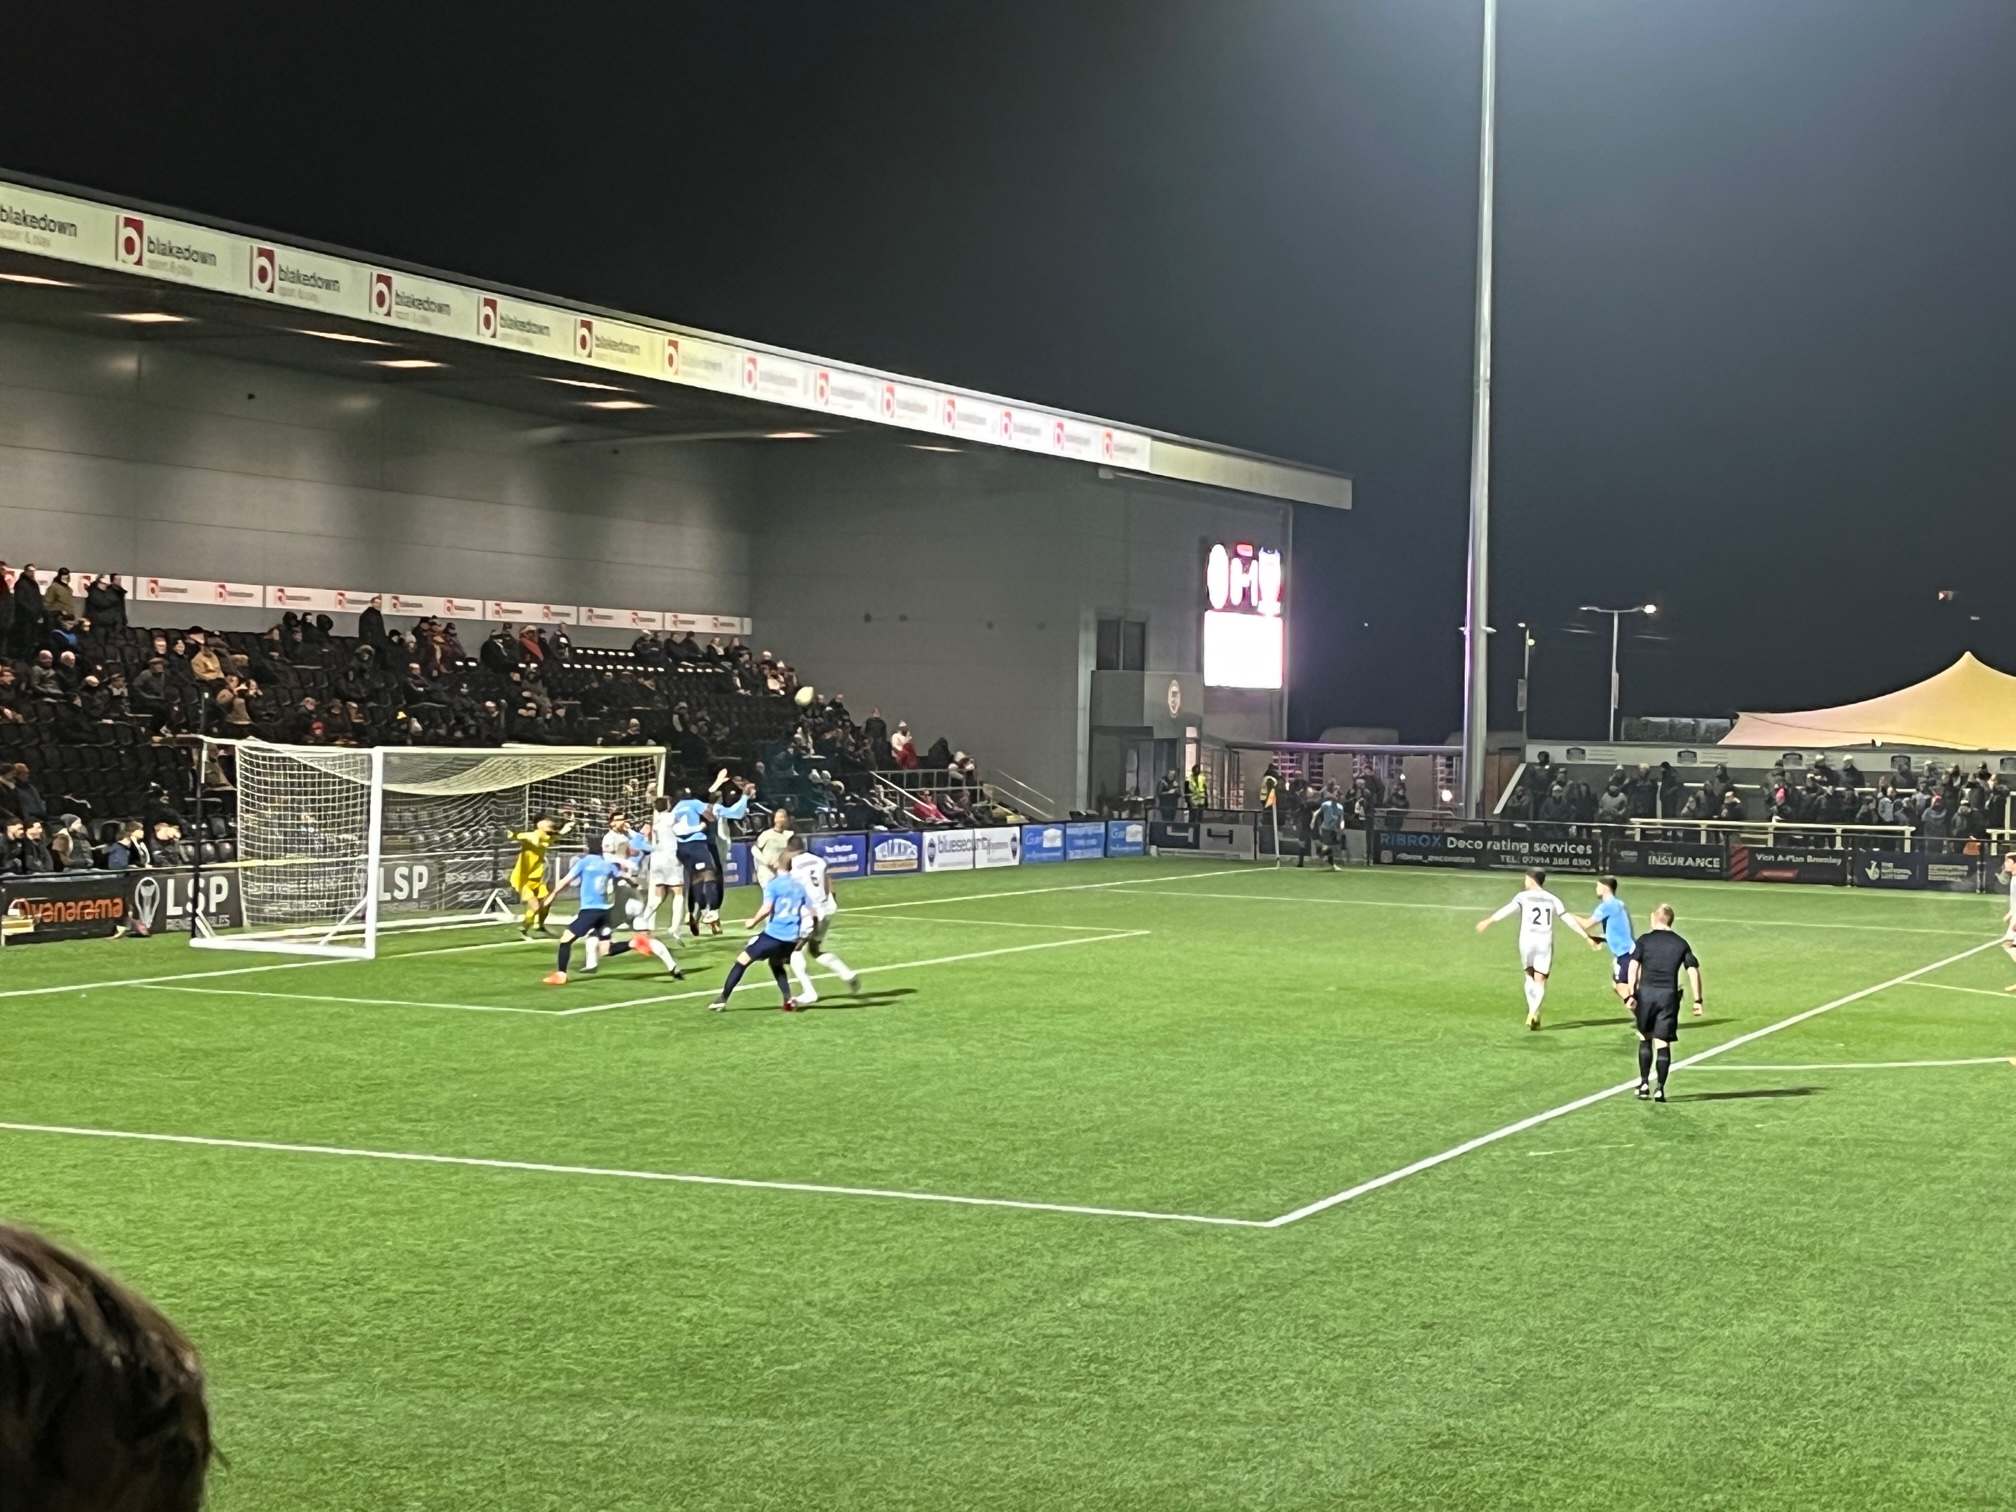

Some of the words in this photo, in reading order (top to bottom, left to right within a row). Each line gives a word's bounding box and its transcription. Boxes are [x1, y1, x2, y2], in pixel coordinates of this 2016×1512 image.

[147, 236, 217, 266] blakedown
[1533, 841, 1593, 855] services
[1647, 855, 1721, 868] INSURANCE
[378, 865, 429, 902] LSP
[165, 876, 229, 916] LSP
[1532, 907, 1551, 926] 21
